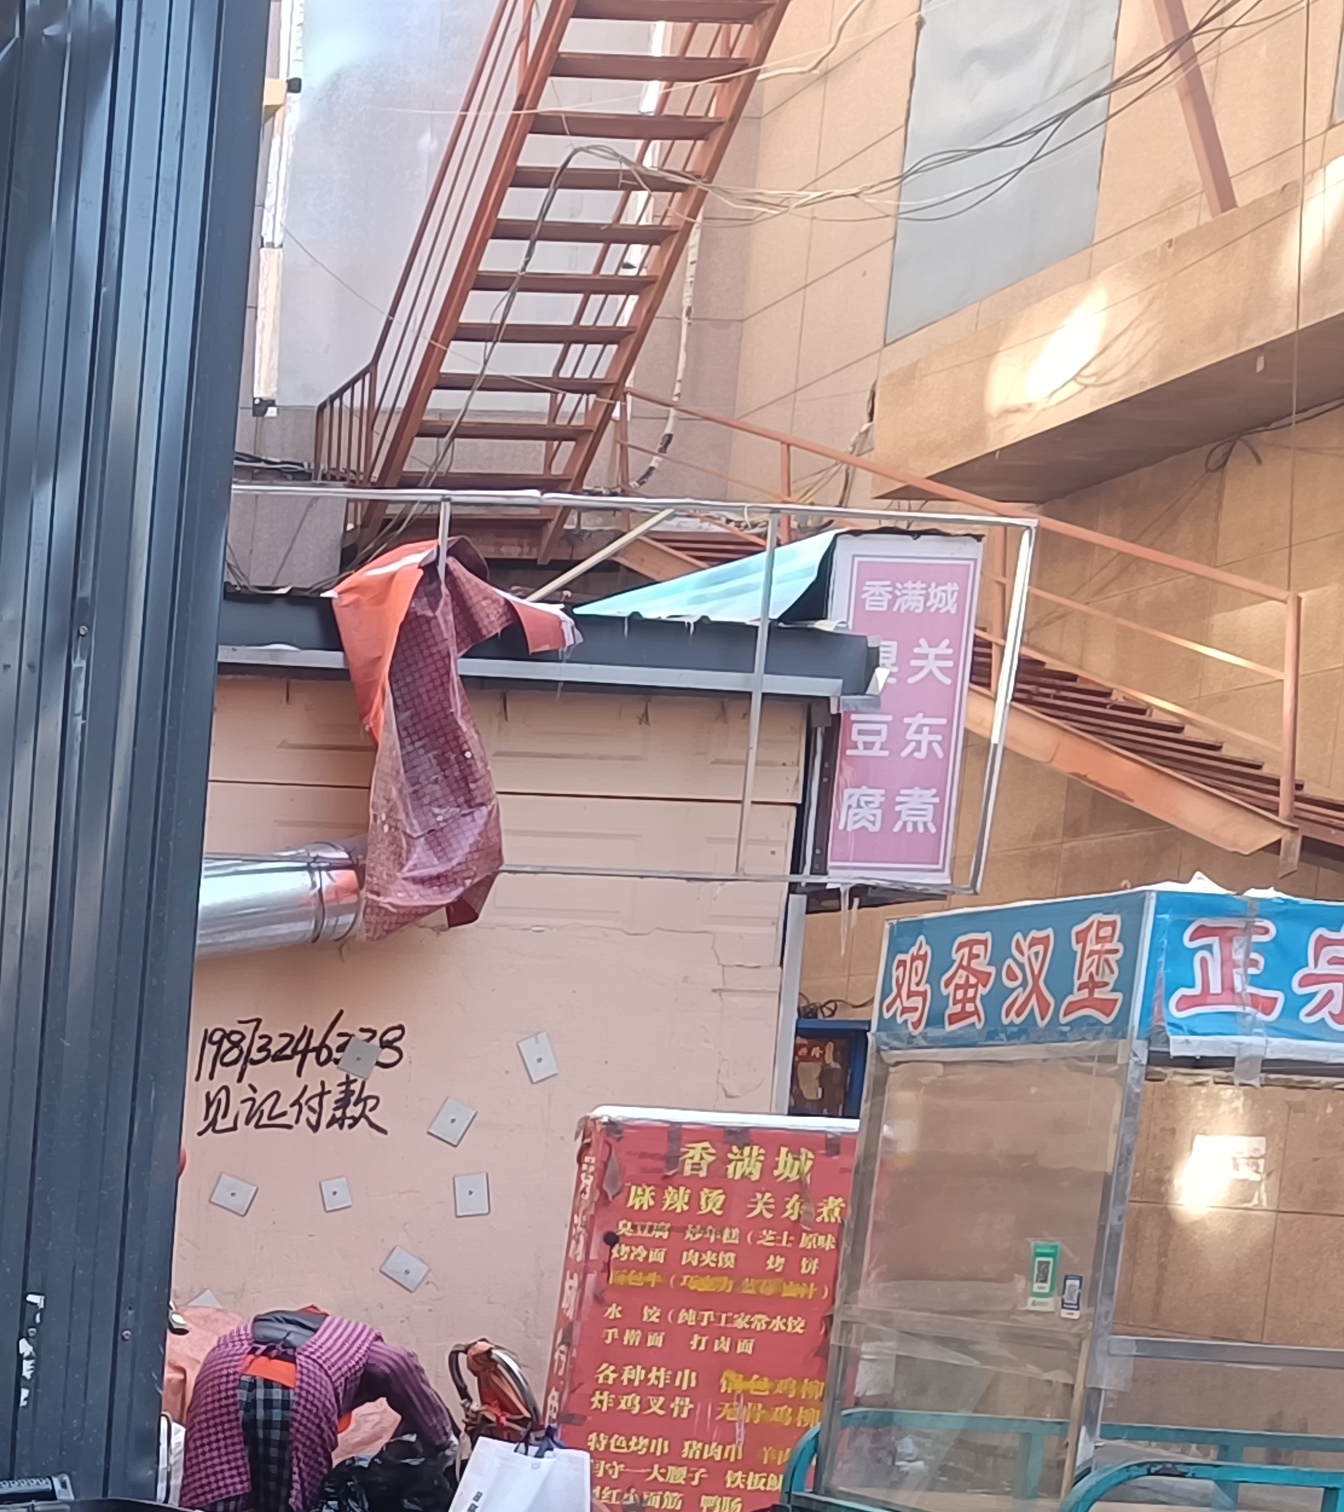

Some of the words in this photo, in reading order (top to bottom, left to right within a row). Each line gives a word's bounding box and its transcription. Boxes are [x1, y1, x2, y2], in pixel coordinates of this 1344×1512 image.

[860, 579, 960, 615] 香满城
[892, 637, 955, 834] 关东煮
[882, 913, 1124, 1035] 鸡蛋汉堡
[681, 1140, 815, 1185] 香满城
[626, 1183, 727, 1216] 麻辣烫
[745, 1188, 846, 1224] 关东煮
[611, 1243, 667, 1264] 烤冷面
[680, 1248, 737, 1269] 肉夹馍
[600, 1328, 666, 1349] 手擀面
[689, 1333, 755, 1356] 打卤面
[593, 1363, 698, 1391] 各种炸串
[589, 1391, 694, 1419] 炸鸡叉骨
[587, 1431, 670, 1457] 特色烤串
